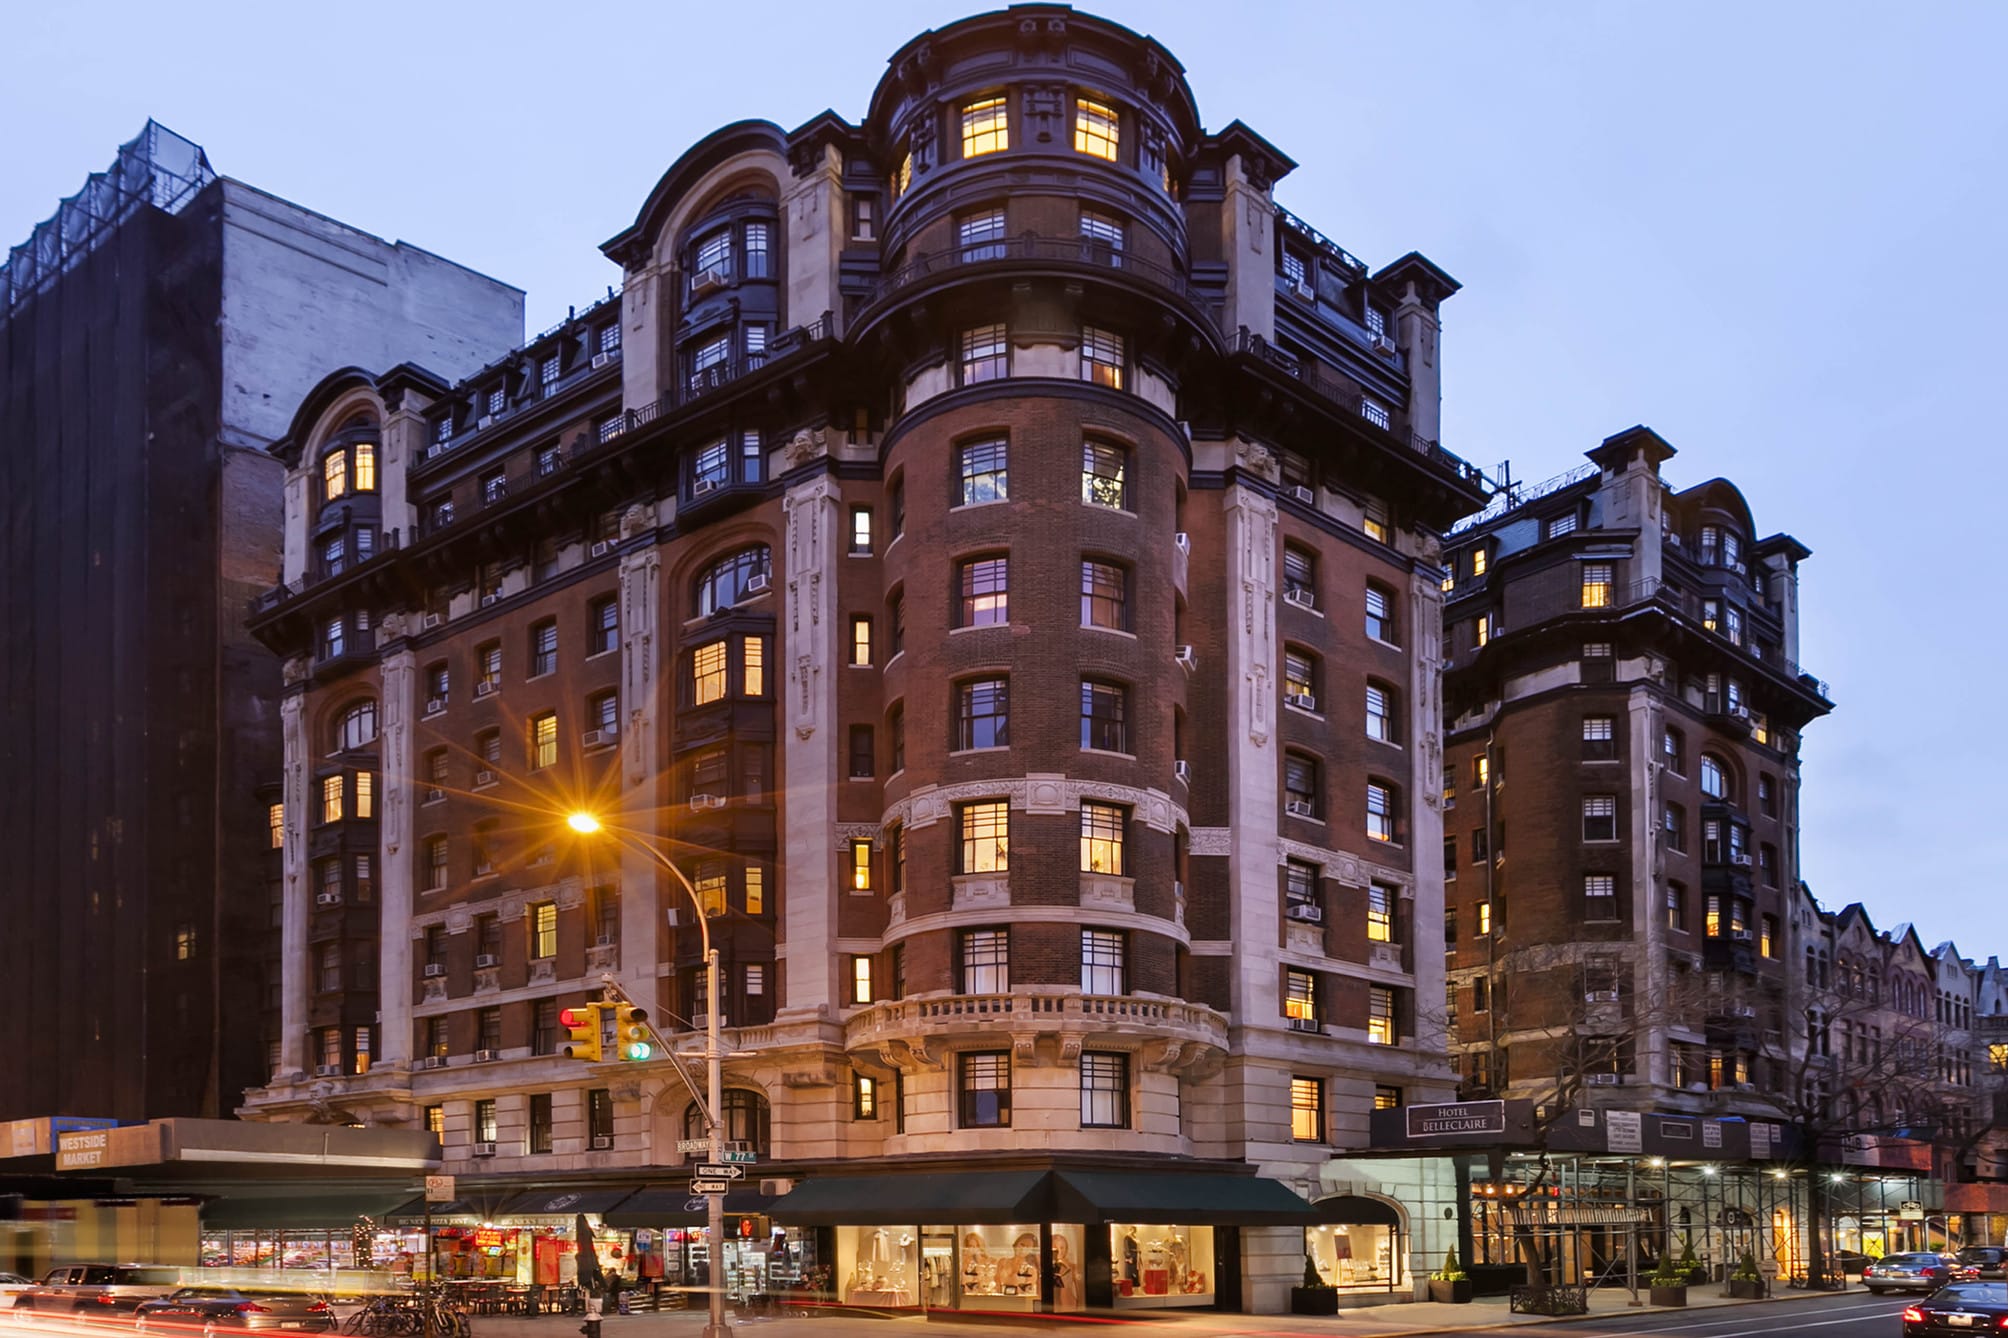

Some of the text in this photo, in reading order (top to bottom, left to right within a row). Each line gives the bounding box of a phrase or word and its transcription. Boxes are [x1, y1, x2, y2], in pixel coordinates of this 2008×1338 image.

[1438, 1107, 1468, 1117] HOTEL
[1423, 1119, 1487, 1132] BELLECLAIRE
[59, 1134, 106, 1150] WESTSIDE
[677, 1140, 709, 1152] BROADWAY
[63, 1151, 102, 1166] MARKET
[724, 1151, 732, 1161] W
[735, 1152, 745, 1161] 77
